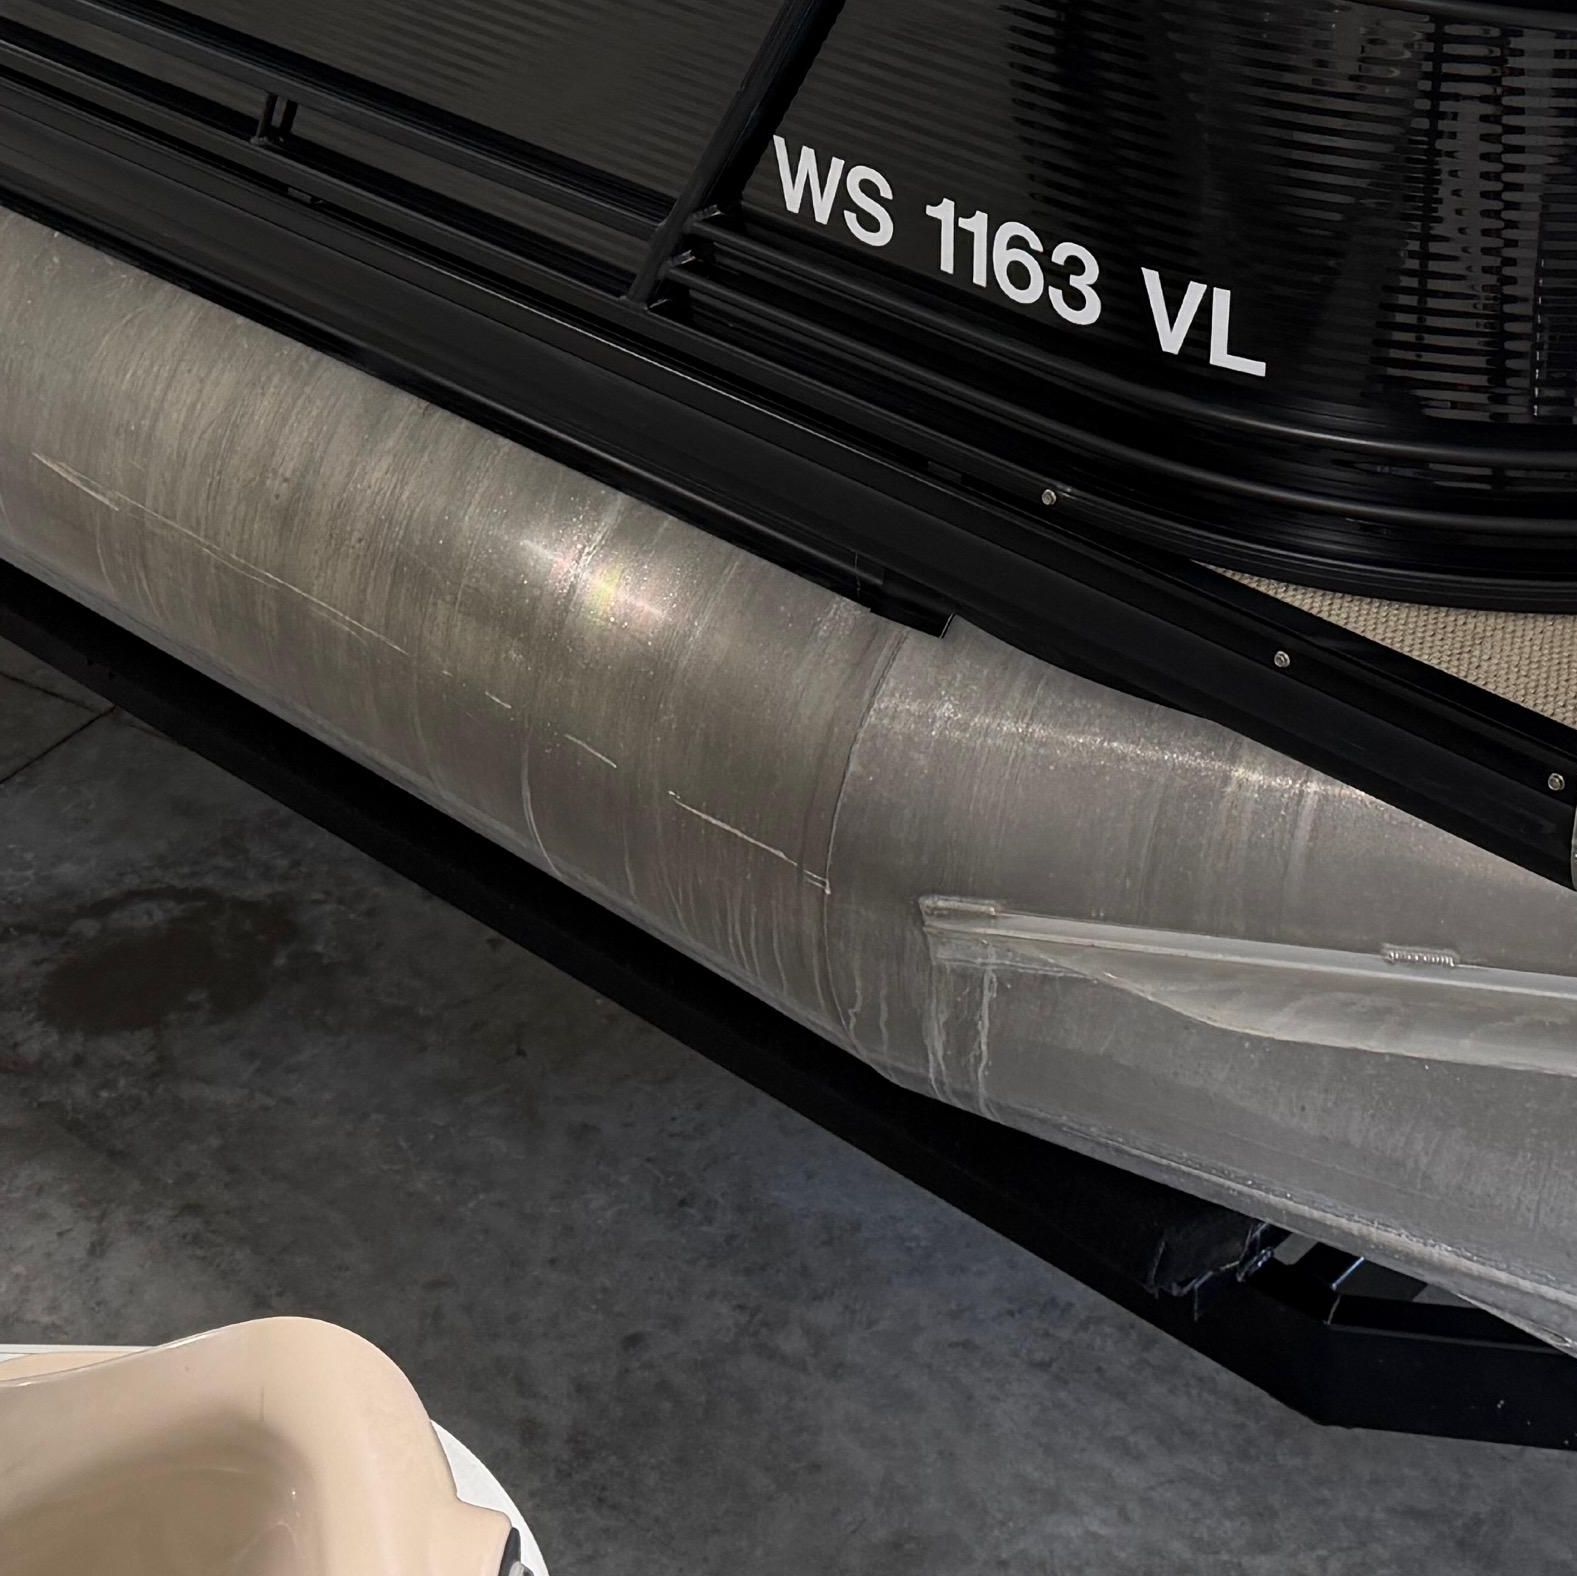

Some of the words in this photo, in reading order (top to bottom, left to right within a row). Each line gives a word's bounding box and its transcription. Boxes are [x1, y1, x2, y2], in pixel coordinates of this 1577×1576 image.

[773, 134, 894, 247] WS
[925, 197, 1102, 326] 1163
[1141, 267, 1267, 377] VL
